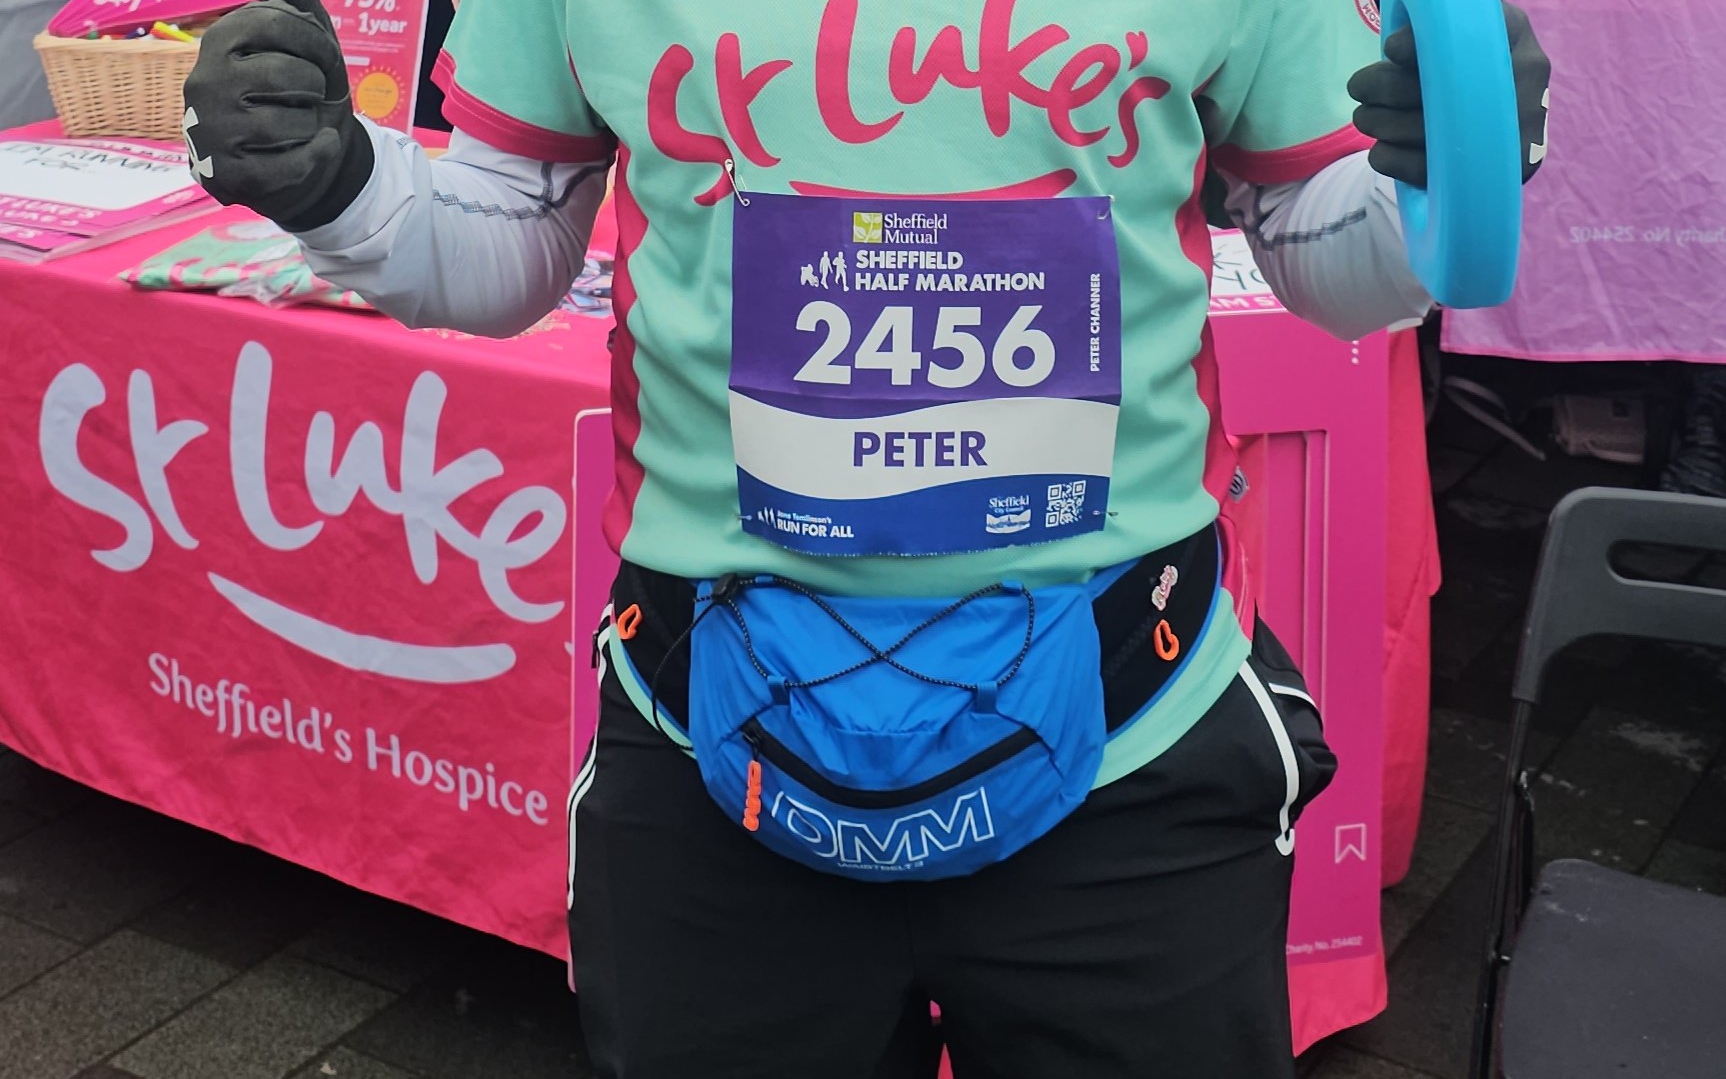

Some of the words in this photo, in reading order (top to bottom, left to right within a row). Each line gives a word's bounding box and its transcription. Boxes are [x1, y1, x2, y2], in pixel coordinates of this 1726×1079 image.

[648, 33, 793, 206] St
[884, 213, 948, 230] Sheffield
[885, 229, 939, 245] Mutual
[856, 250, 964, 270] SHEFFIELD
[855, 272, 910, 291] HALF
[915, 272, 1045, 292] MARATHON
[1090, 273, 1101, 334] CHANNER
[793, 300, 1056, 389] 2456
[1090, 337, 1100, 372] PETER
[39, 362, 208, 572] St
[852, 431, 988, 468] PETER
[989, 495, 1030, 508] Sheffield
[777, 518, 800, 534] RUN
[802, 523, 827, 537] FOR
[829, 525, 854, 538] ALL
[148, 653, 353, 762] Sheffield's
[366, 727, 549, 825] Hospice
